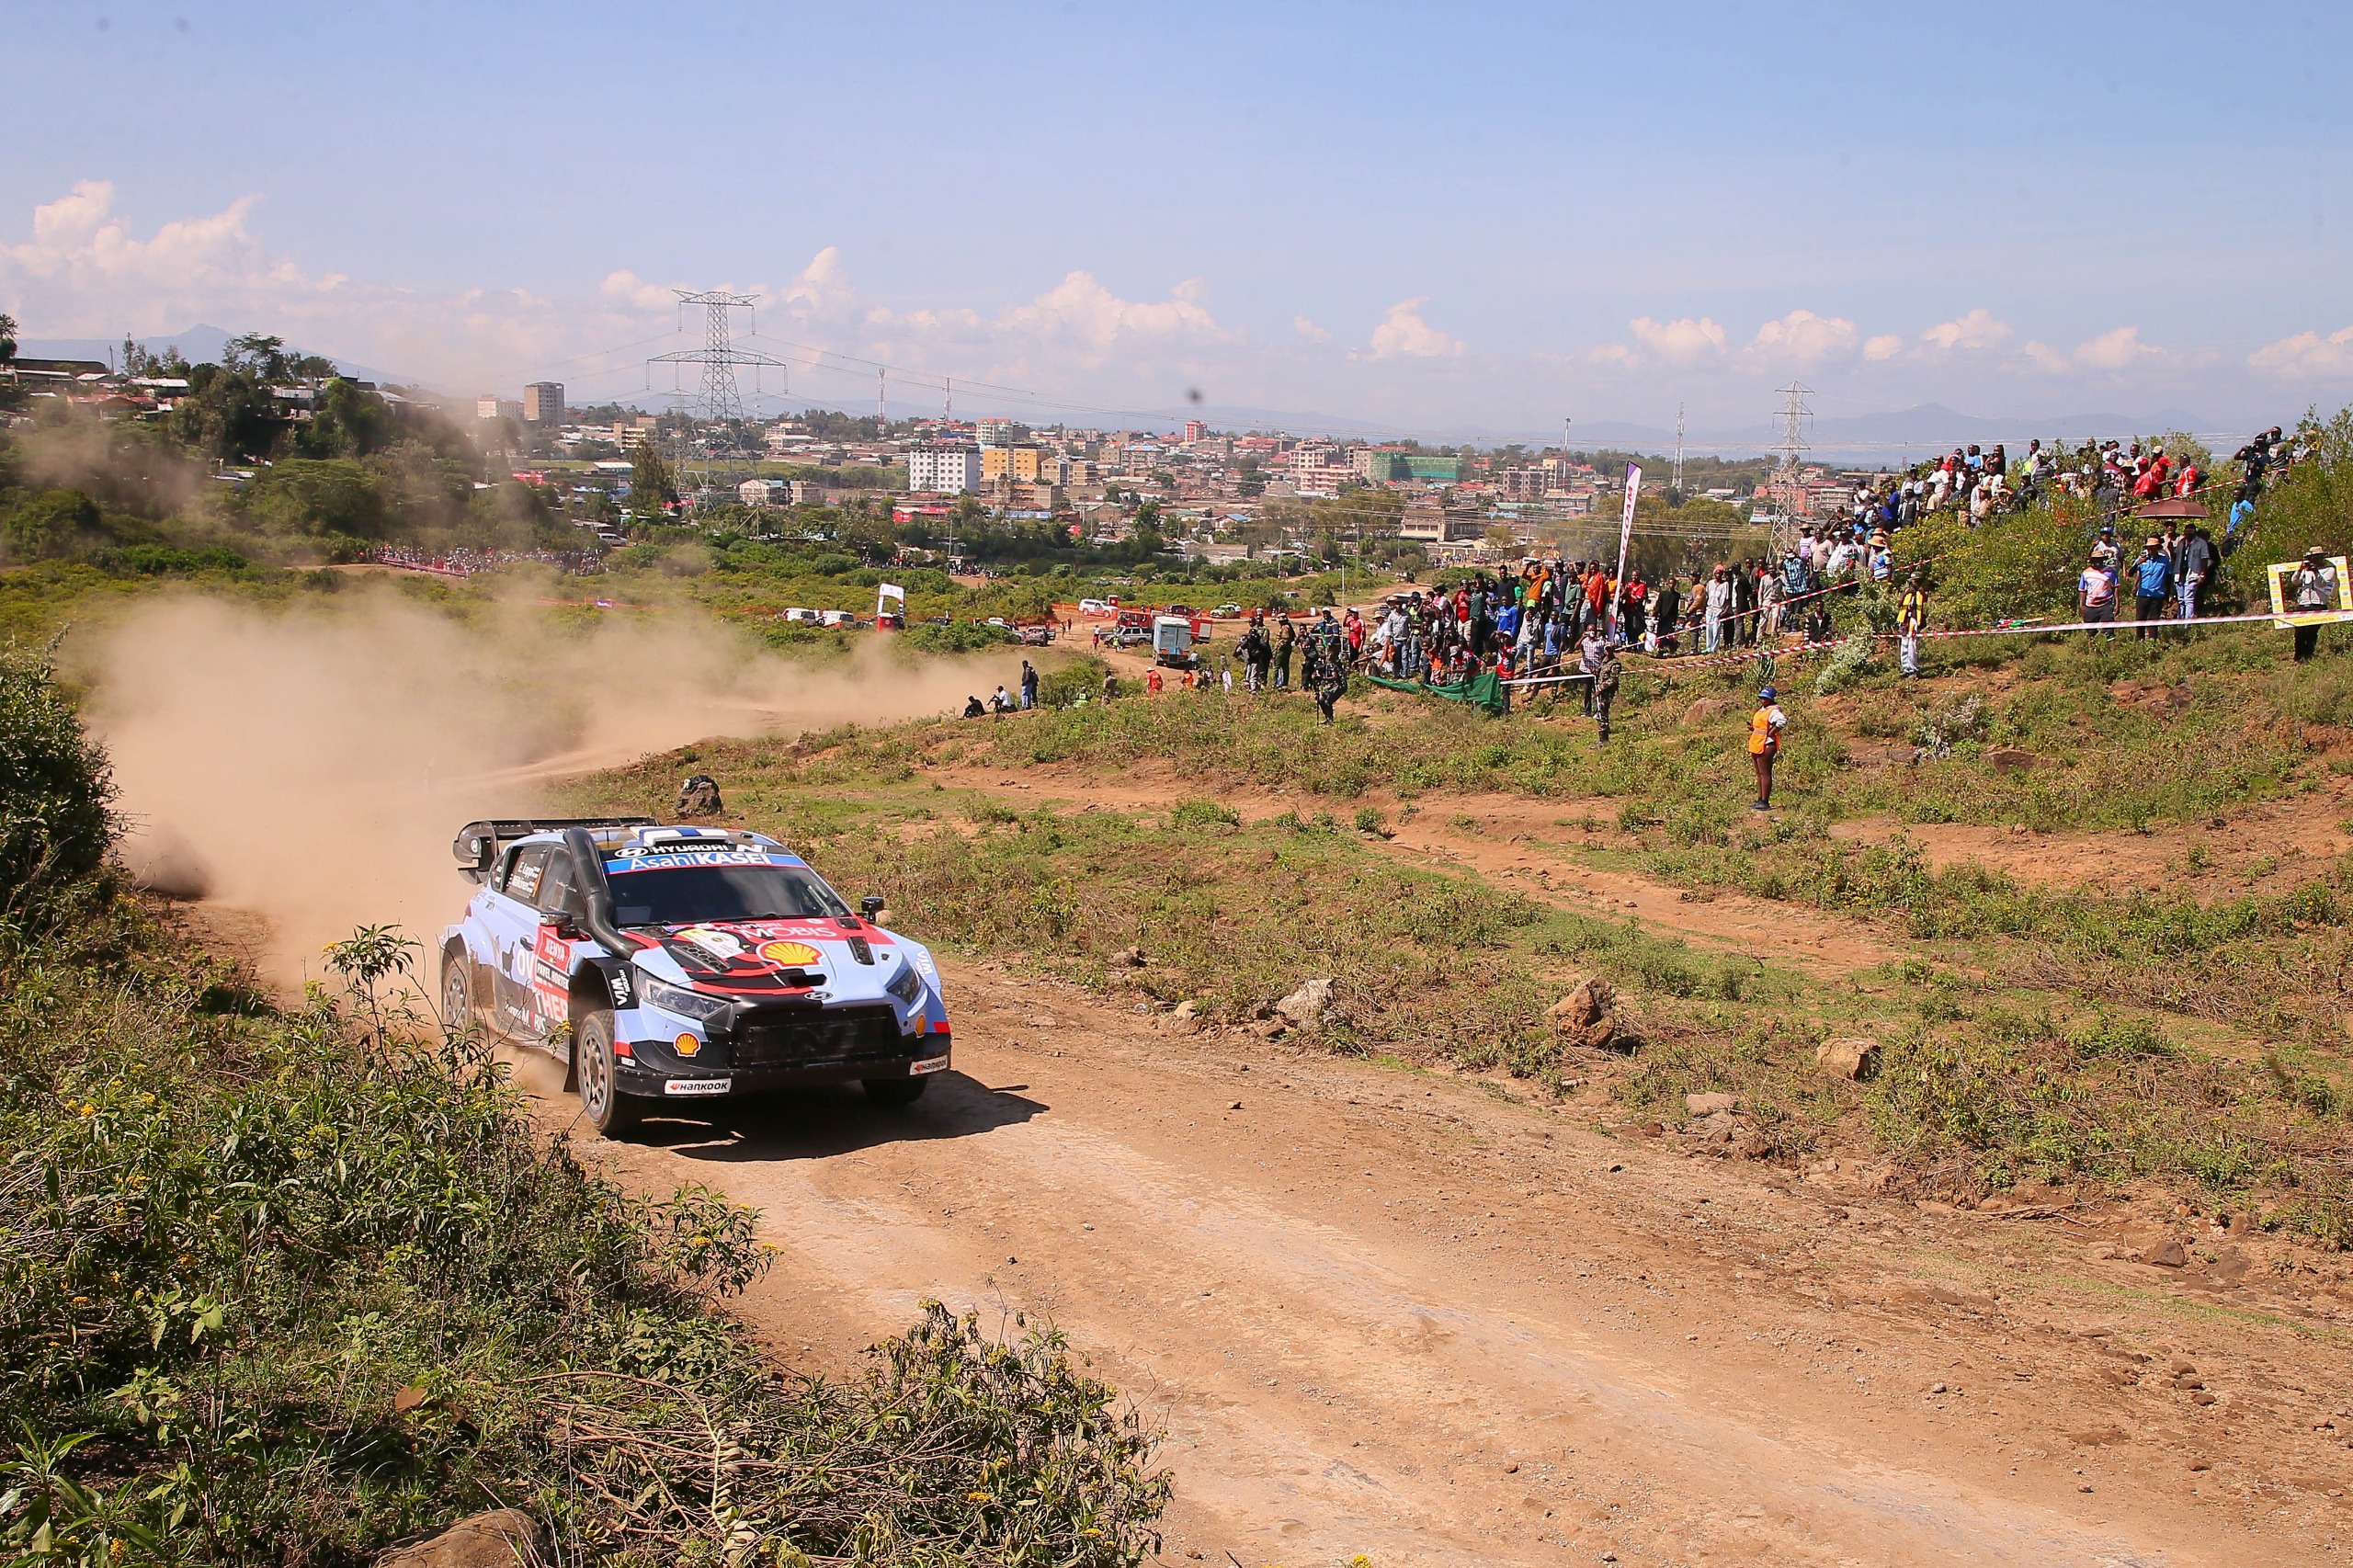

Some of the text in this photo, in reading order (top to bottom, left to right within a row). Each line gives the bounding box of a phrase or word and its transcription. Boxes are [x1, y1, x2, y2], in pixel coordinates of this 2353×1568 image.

[651, 844, 729, 855] HYUNDAI
[713, 922, 782, 932] HYUNDAI
[738, 926, 837, 938] MOBIS
[544, 937, 565, 961] KENYA
[537, 962, 551, 982] PAVEL
